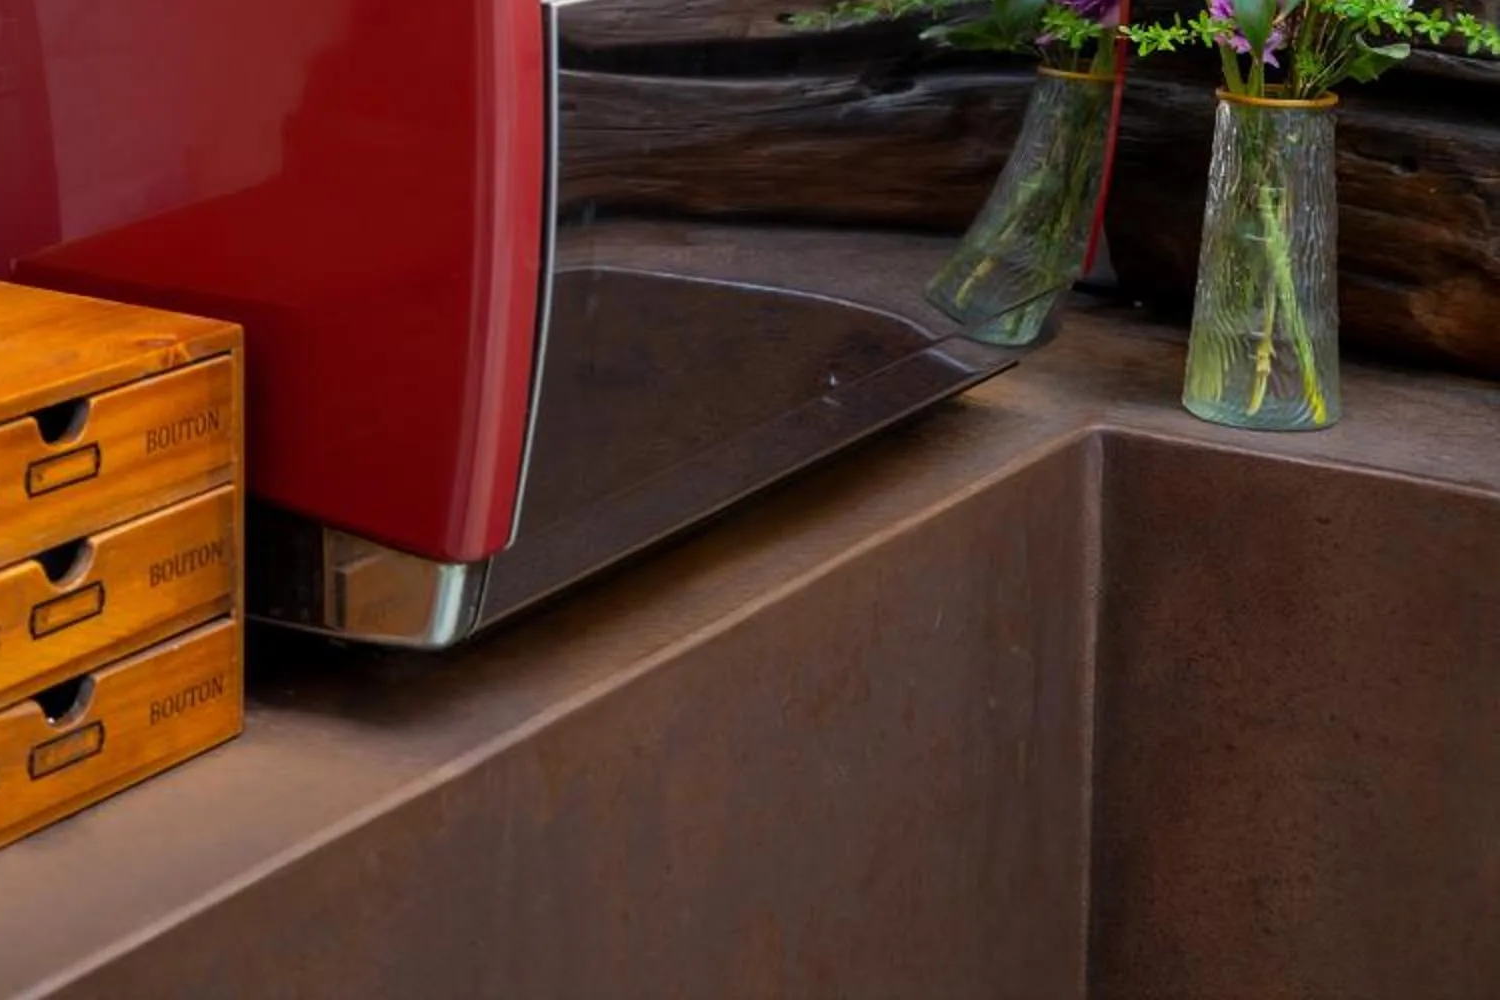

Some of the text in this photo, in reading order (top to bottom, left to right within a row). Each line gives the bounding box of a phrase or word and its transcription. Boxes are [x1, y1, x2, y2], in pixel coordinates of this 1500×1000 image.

[145, 409, 221, 455] BOUTON
[148, 539, 225, 588] BOUTON
[149, 674, 225, 726] BOUTON
